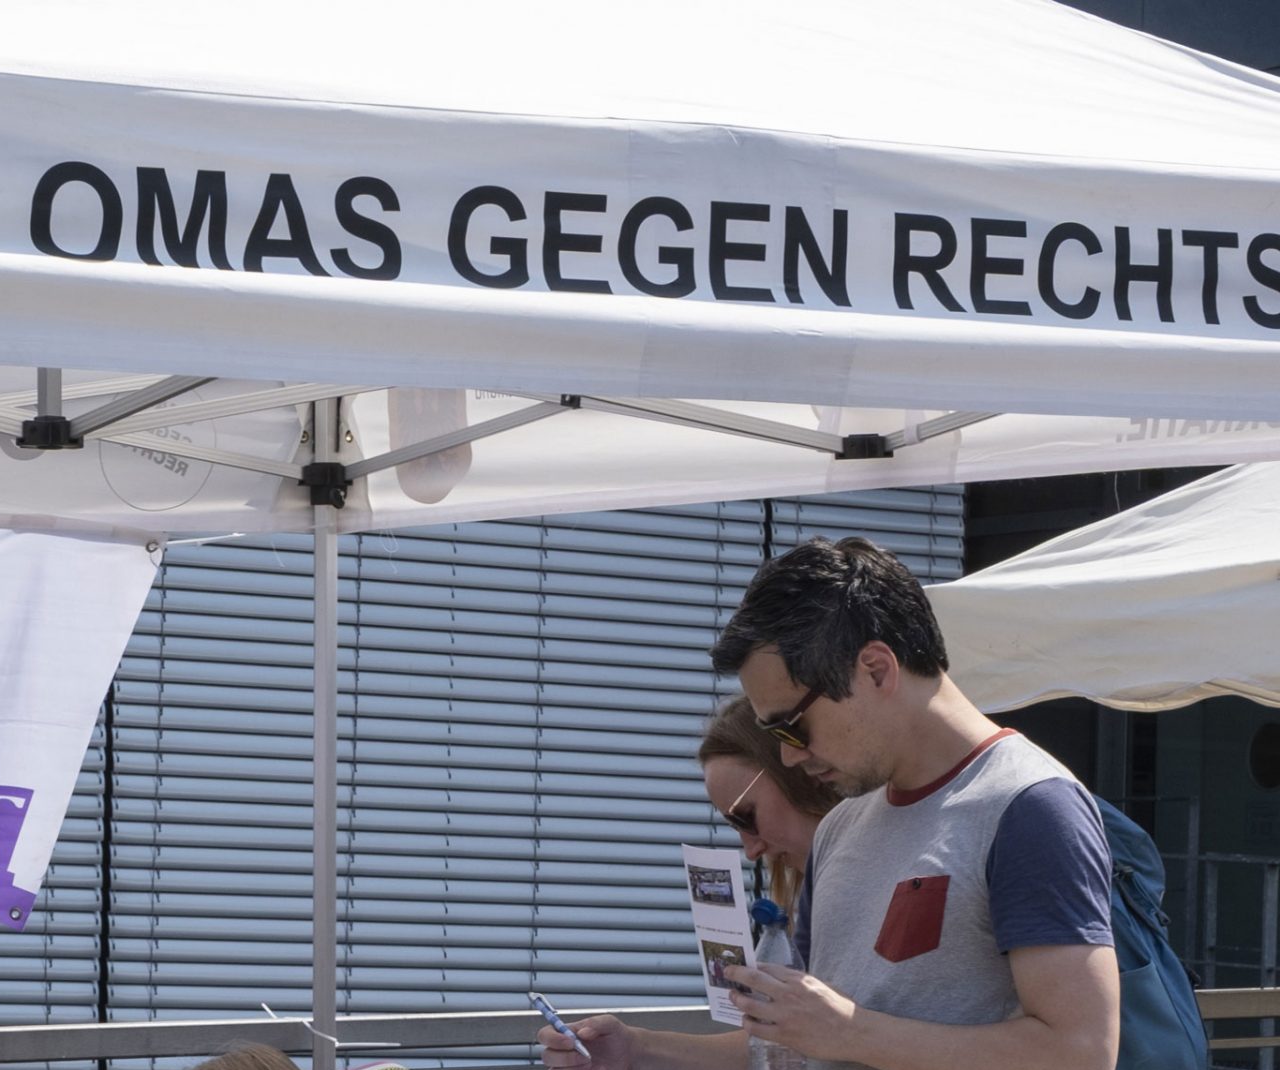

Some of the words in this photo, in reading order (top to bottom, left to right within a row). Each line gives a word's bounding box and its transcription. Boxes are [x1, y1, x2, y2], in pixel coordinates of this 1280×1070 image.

[30, 161, 402, 281] OMAS
[447, 185, 851, 308] GEGEN
[892, 211, 1280, 330] RECHTS
